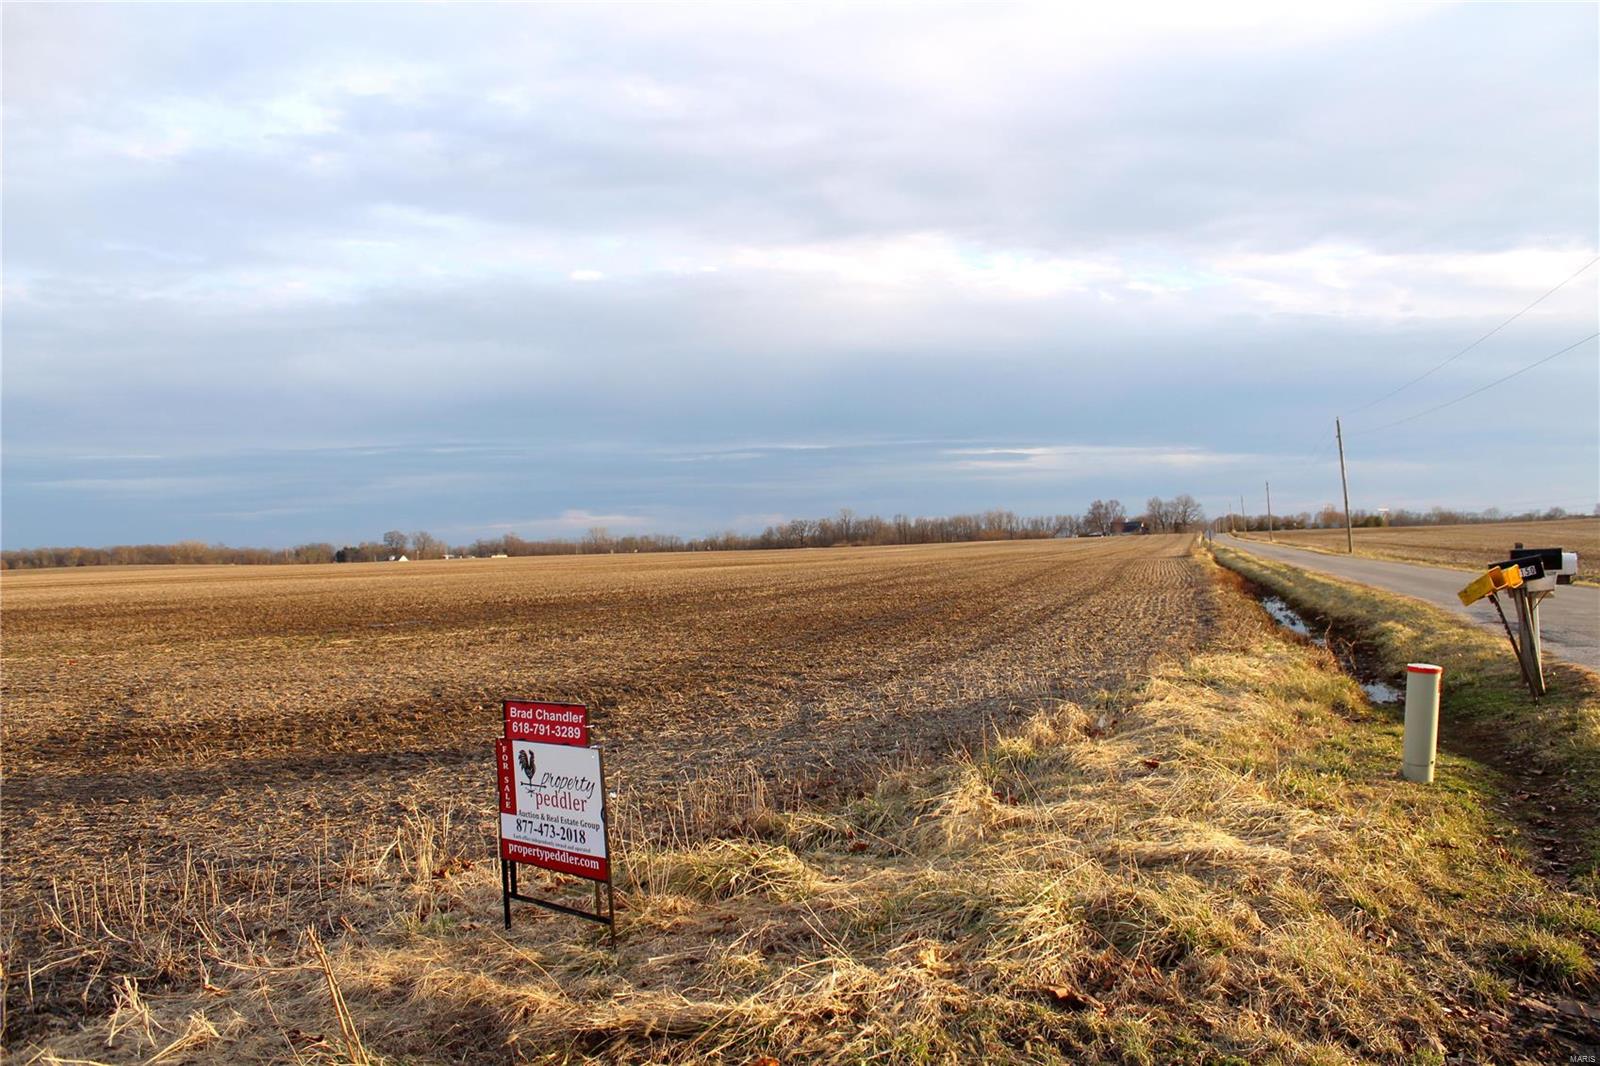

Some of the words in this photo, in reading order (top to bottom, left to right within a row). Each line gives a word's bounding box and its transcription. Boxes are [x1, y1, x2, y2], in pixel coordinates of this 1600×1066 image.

[510, 707, 533, 719] Brad
[535, 709, 584, 723] Chandler
[512, 721, 581, 739] 618-791-3289
[539, 772, 595, 800] property
[535, 790, 587, 812] peddler
[516, 818, 586, 844] 877-473-2018
[518, 809, 540, 820] Auction
[541, 813, 545, 821] &
[547, 814, 560, 823] Real
[560, 816, 579, 827] Estate
[580, 820, 600, 832] Group
[508, 843, 600, 870] propertypeddler.com
